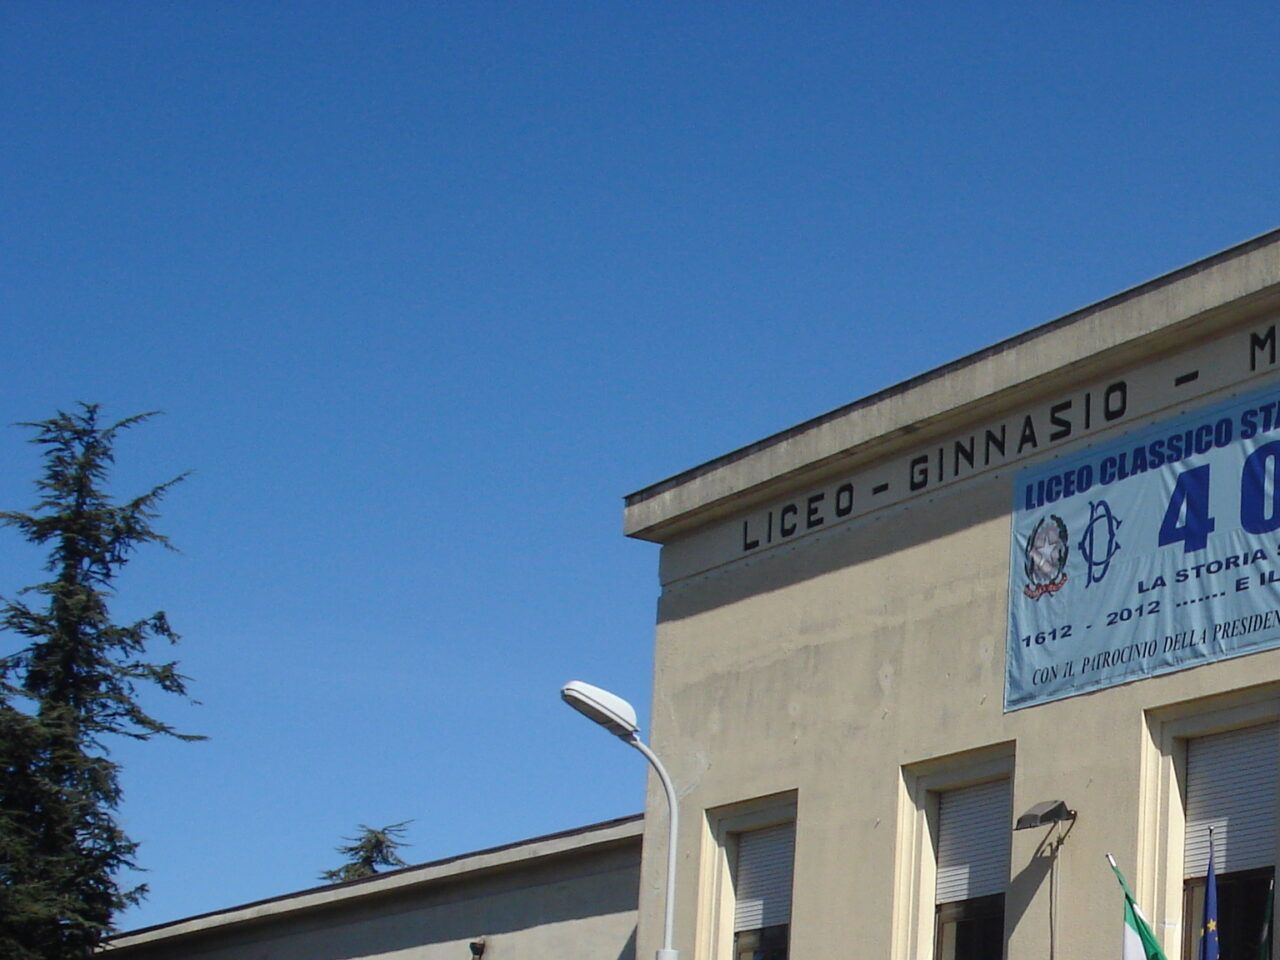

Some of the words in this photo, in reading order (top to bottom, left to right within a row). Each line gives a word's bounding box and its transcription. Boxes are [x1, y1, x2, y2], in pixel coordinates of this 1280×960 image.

[743, 482, 854, 552] LICEO
[909, 380, 1128, 491] GINNASIO
[1024, 464, 1093, 511] LICEO
[1099, 417, 1234, 486] CLASSICO
[1137, 578, 1167, 594] LA
[1175, 550, 1268, 584] STORIA
[1021, 624, 1073, 648] 1612
[1106, 601, 1161, 627] 2012
[1235, 577, 1250, 592] E
[1032, 664, 1058, 686] CON
[1081, 640, 1158, 674] PATROCINIO
[1163, 630, 1207, 653] DELLA
